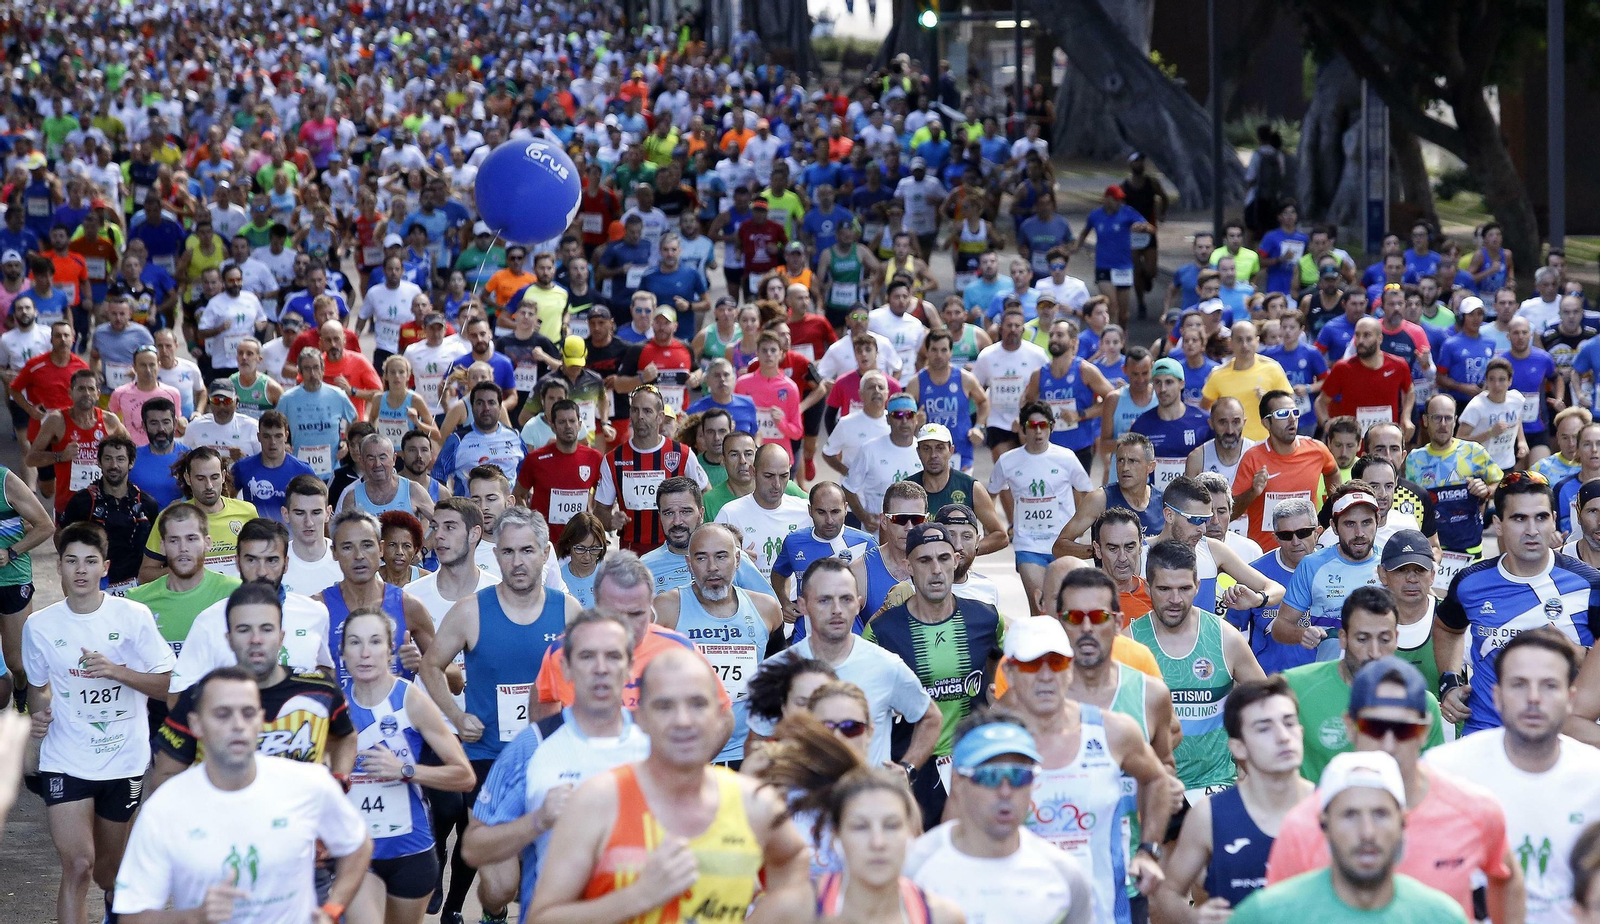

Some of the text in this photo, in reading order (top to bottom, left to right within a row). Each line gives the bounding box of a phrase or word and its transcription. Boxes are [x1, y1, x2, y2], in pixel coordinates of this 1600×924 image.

[925, 396, 958, 413] RCM
[298, 420, 332, 432] nerja
[385, 427, 402, 436] 320
[557, 502, 583, 513] 1088
[1025, 509, 1053, 521] 2402
[687, 625, 743, 642] nerja
[80, 685, 122, 704] 1287
[1171, 690, 1213, 702] ETISMO
[1174, 704, 1218, 718] MOLINOS
[361, 796, 384, 813] 44
